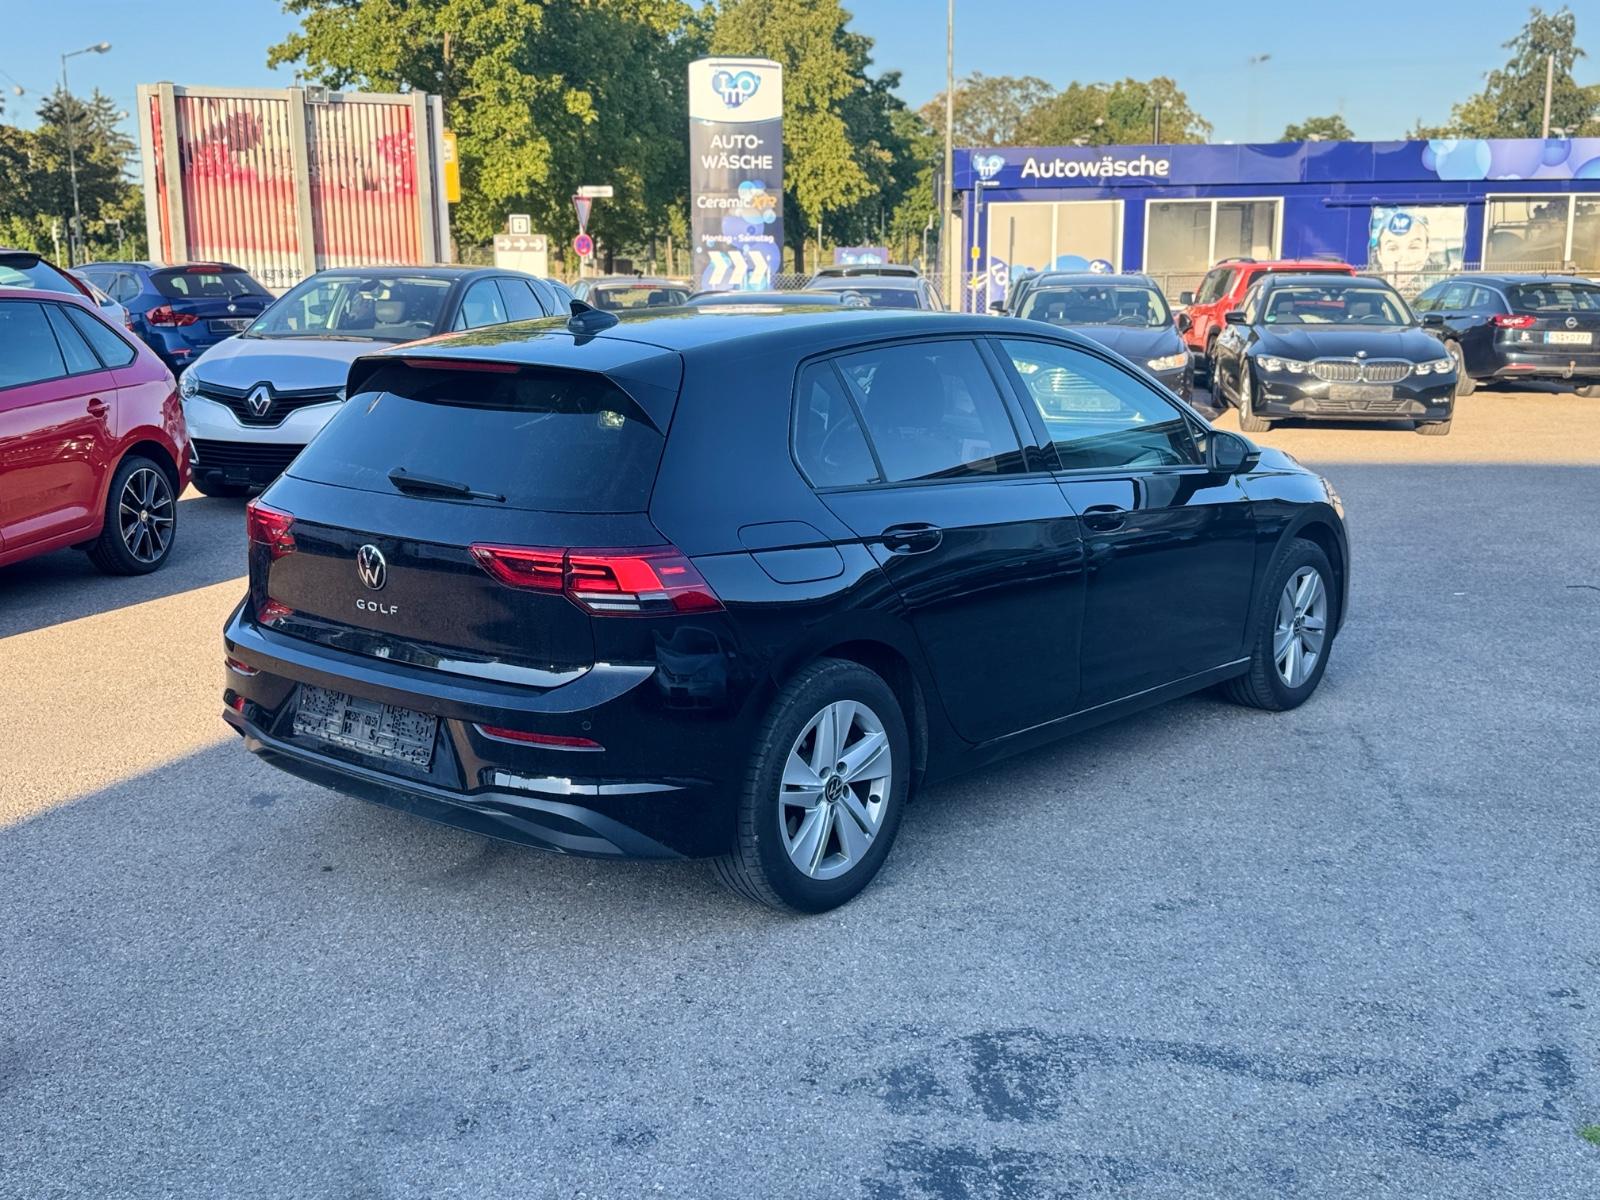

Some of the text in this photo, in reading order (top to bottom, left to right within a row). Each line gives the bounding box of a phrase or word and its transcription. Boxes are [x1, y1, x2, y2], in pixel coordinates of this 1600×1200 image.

[710, 134, 764, 149] AUTO-
[701, 155, 773, 169] WÄSCHE
[1021, 155, 1169, 178] Autowäsche
[697, 195, 751, 208] Ceramic
[702, 234, 732, 244] Montag
[738, 233, 774, 244] Samstag
[356, 599, 398, 615] GOLF
